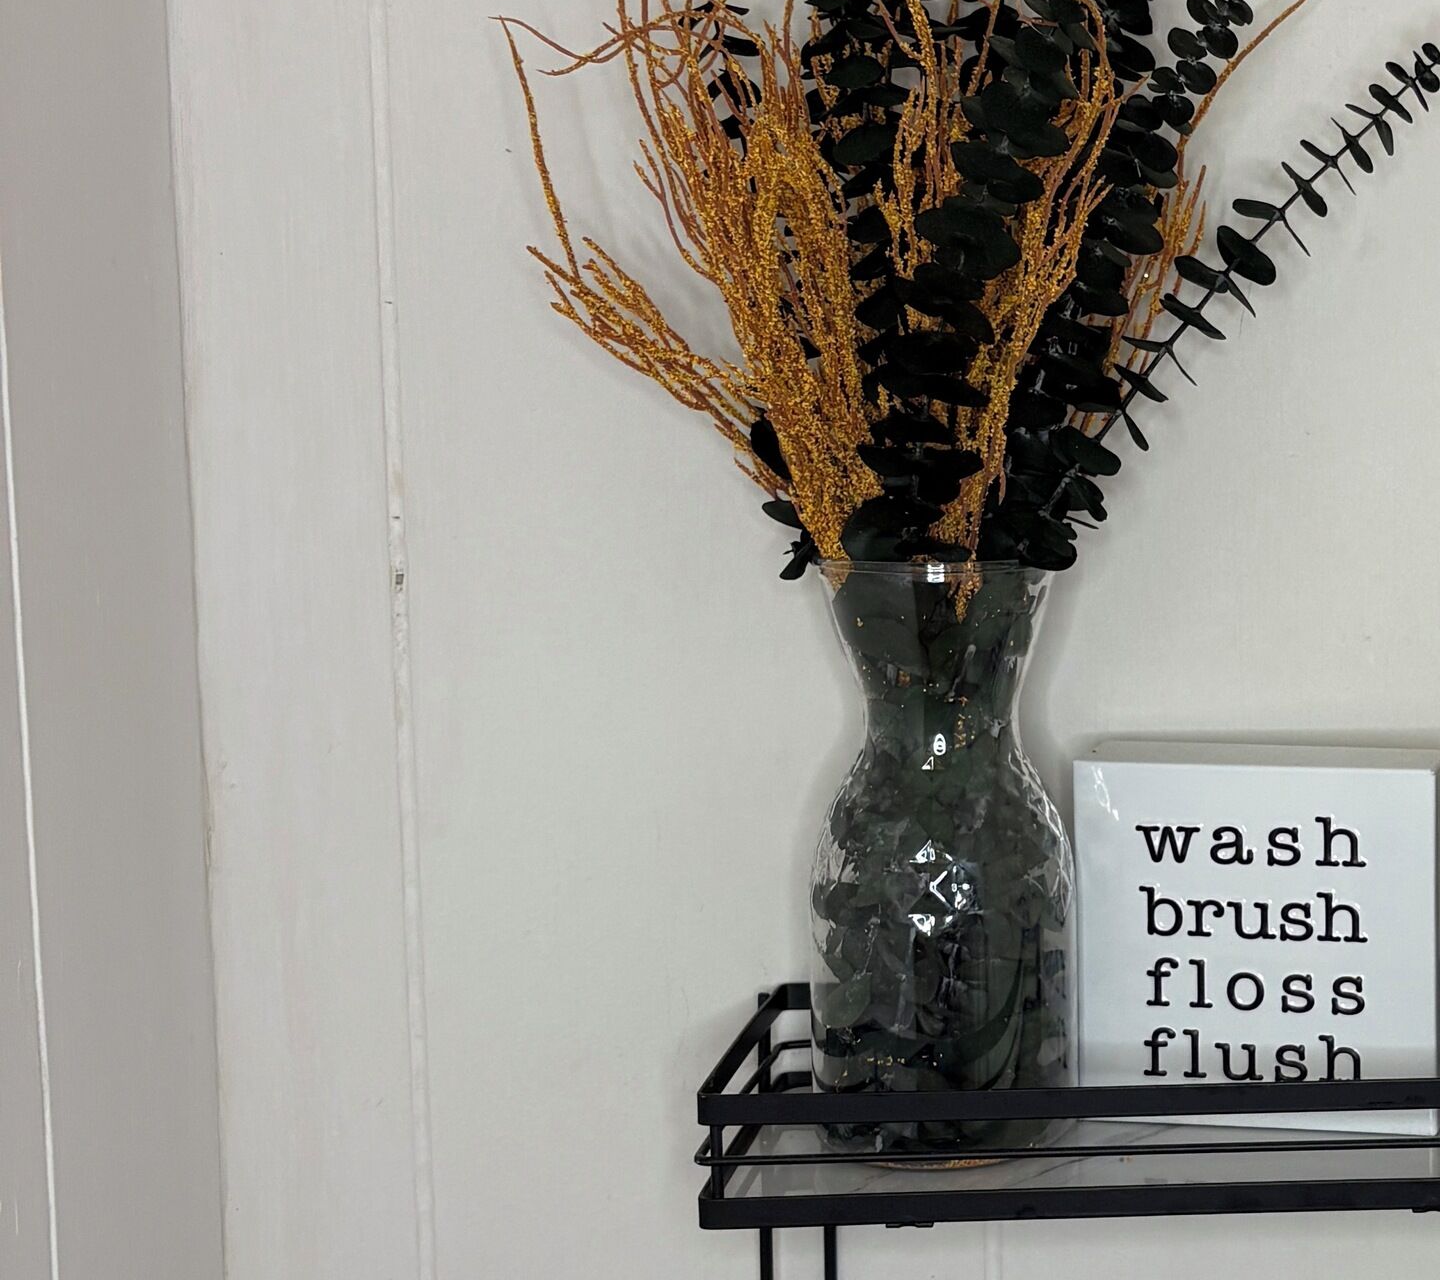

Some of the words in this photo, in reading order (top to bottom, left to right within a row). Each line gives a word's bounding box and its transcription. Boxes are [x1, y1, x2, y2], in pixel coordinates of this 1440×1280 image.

[1135, 815, 1367, 868] wash
[1138, 885, 1368, 943] brush
[1146, 956, 1365, 1016] floss
[1143, 1027, 1361, 1083] flush
